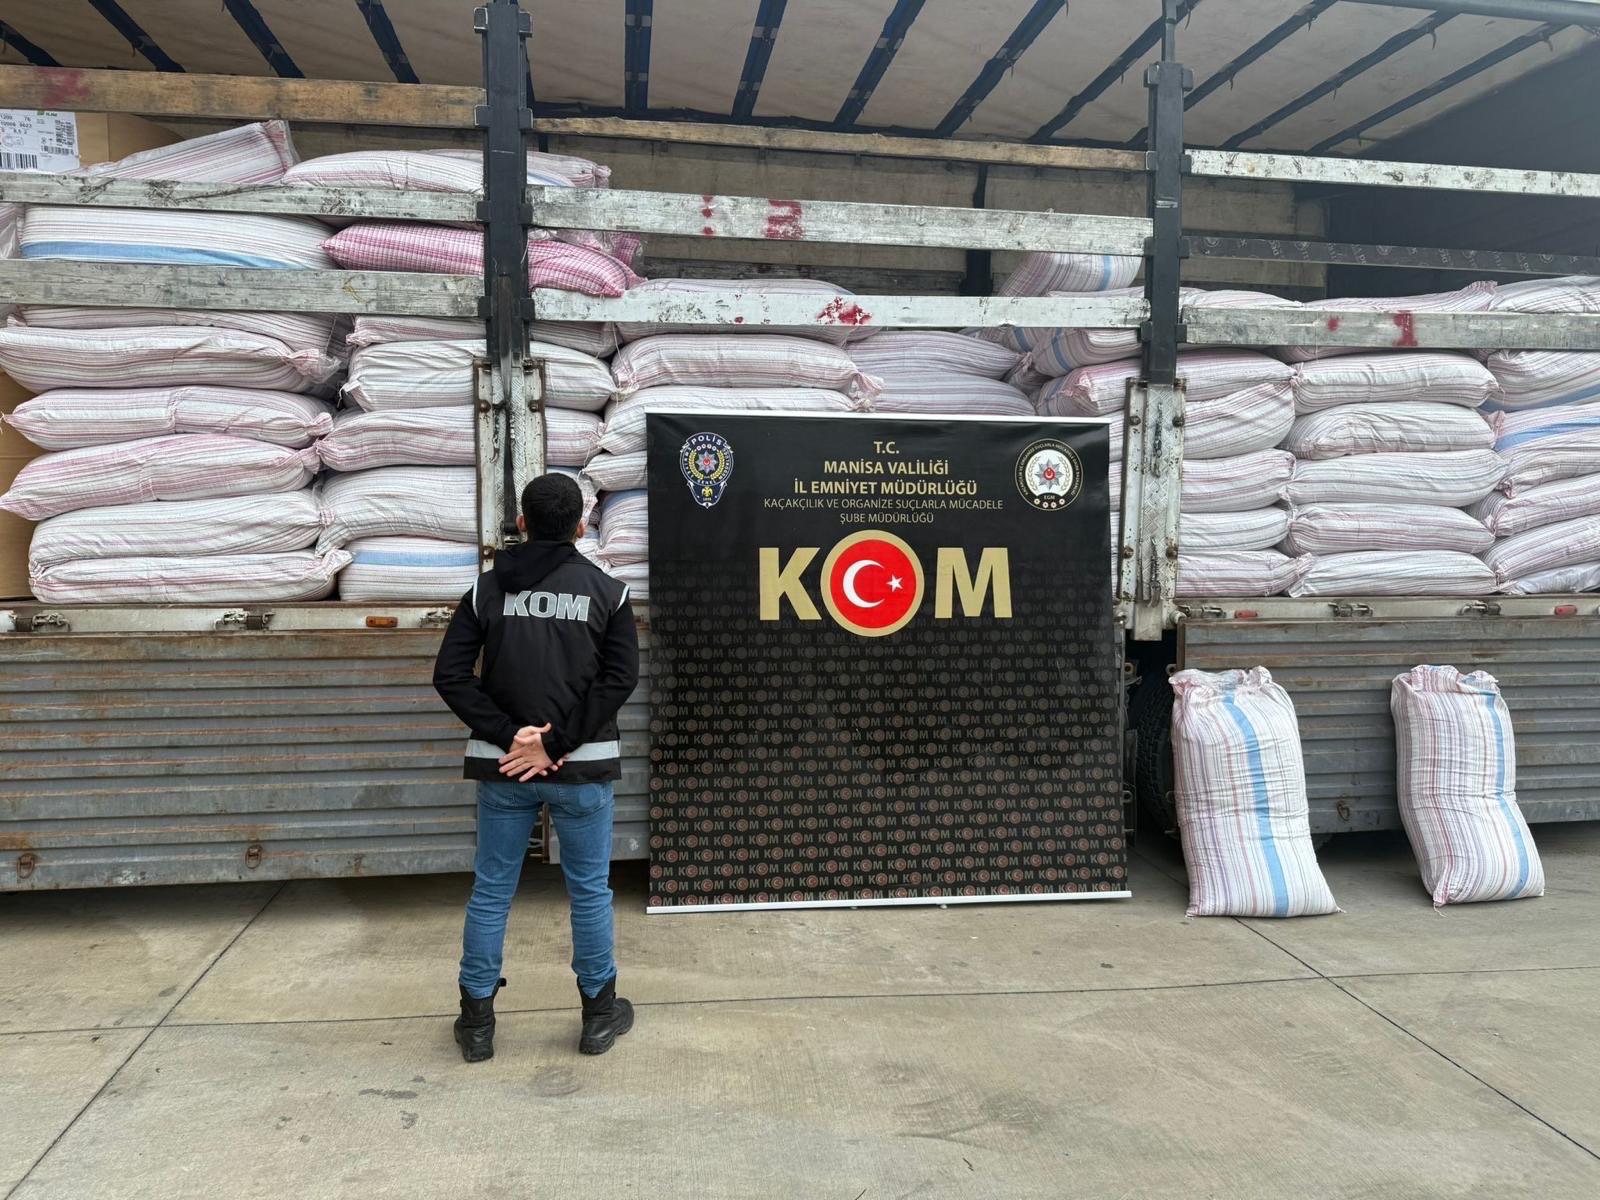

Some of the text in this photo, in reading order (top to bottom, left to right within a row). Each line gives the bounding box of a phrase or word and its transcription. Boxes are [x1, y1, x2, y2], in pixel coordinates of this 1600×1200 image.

[691, 435, 723, 446] POLİS
[874, 441, 900, 454] T.C.
[824, 459, 949, 475] MANİSA VALİLİĞİ
[795, 478, 977, 495] İL EMNİYET MÜDÜRLÜĞÜ
[764, 498, 1003, 511] KAÇAKÇILIK VE ORGANİZE SUÇLARLA MÜCADELE
[840, 511, 934, 524] ŞUBE MÜDÜRLÜĞÜ
[503, 590, 591, 622] KOM
